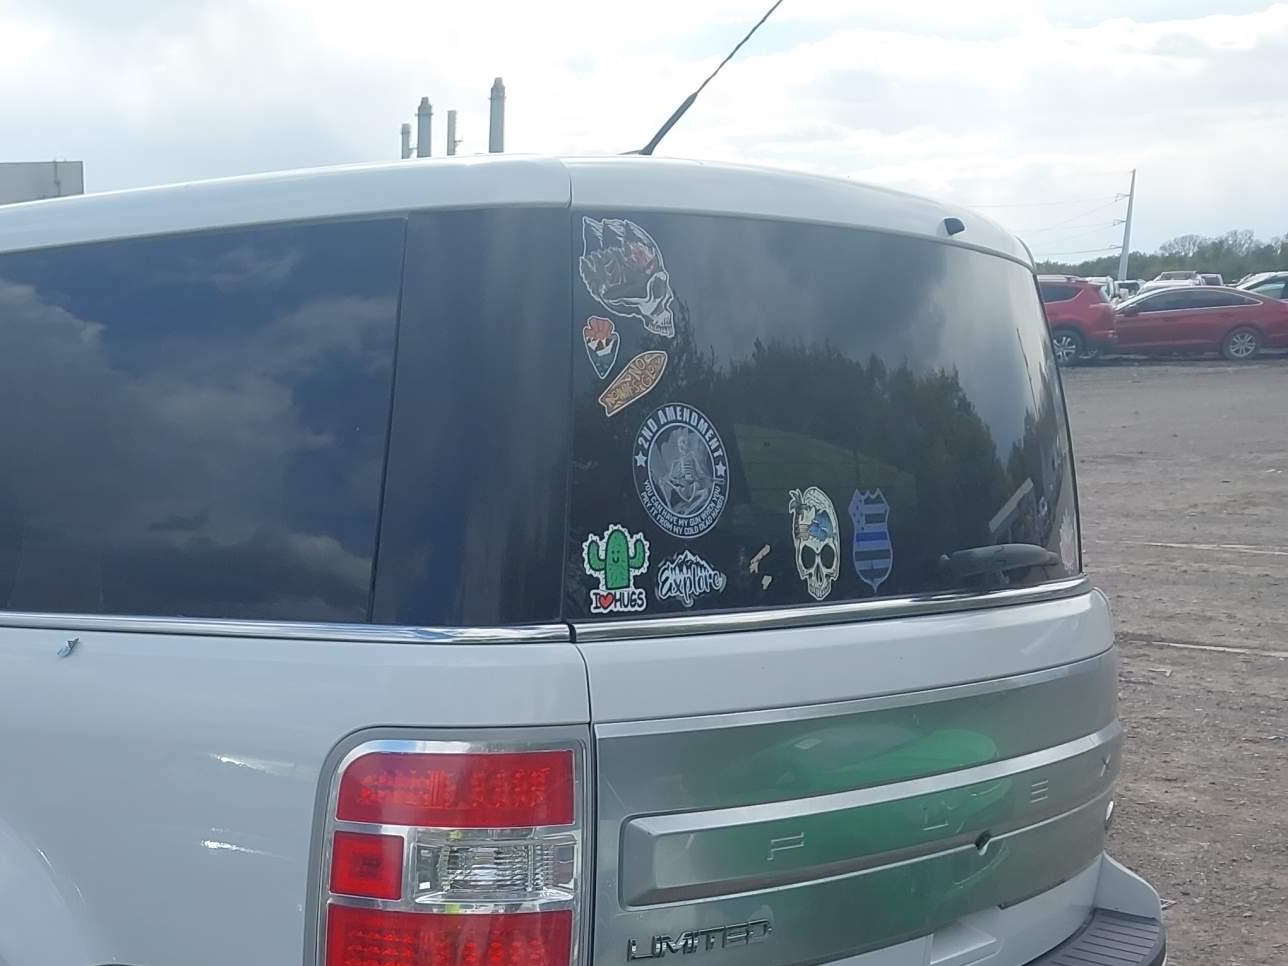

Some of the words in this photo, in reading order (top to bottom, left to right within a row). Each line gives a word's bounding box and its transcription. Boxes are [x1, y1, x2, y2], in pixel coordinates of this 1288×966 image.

[638, 418, 658, 448] 2ND
[657, 406, 723, 458] AMENDMENT
[651, 496, 665, 515] CAN
[662, 509, 678, 525] HAVE
[678, 518, 689, 527] MY
[656, 515, 672, 531] FROM
[673, 525, 683, 535] MY
[684, 526, 699, 535] COLD
[592, 592, 601, 610] I
[613, 590, 646, 609] HUGS
[626, 918, 773, 962] LIMITED
